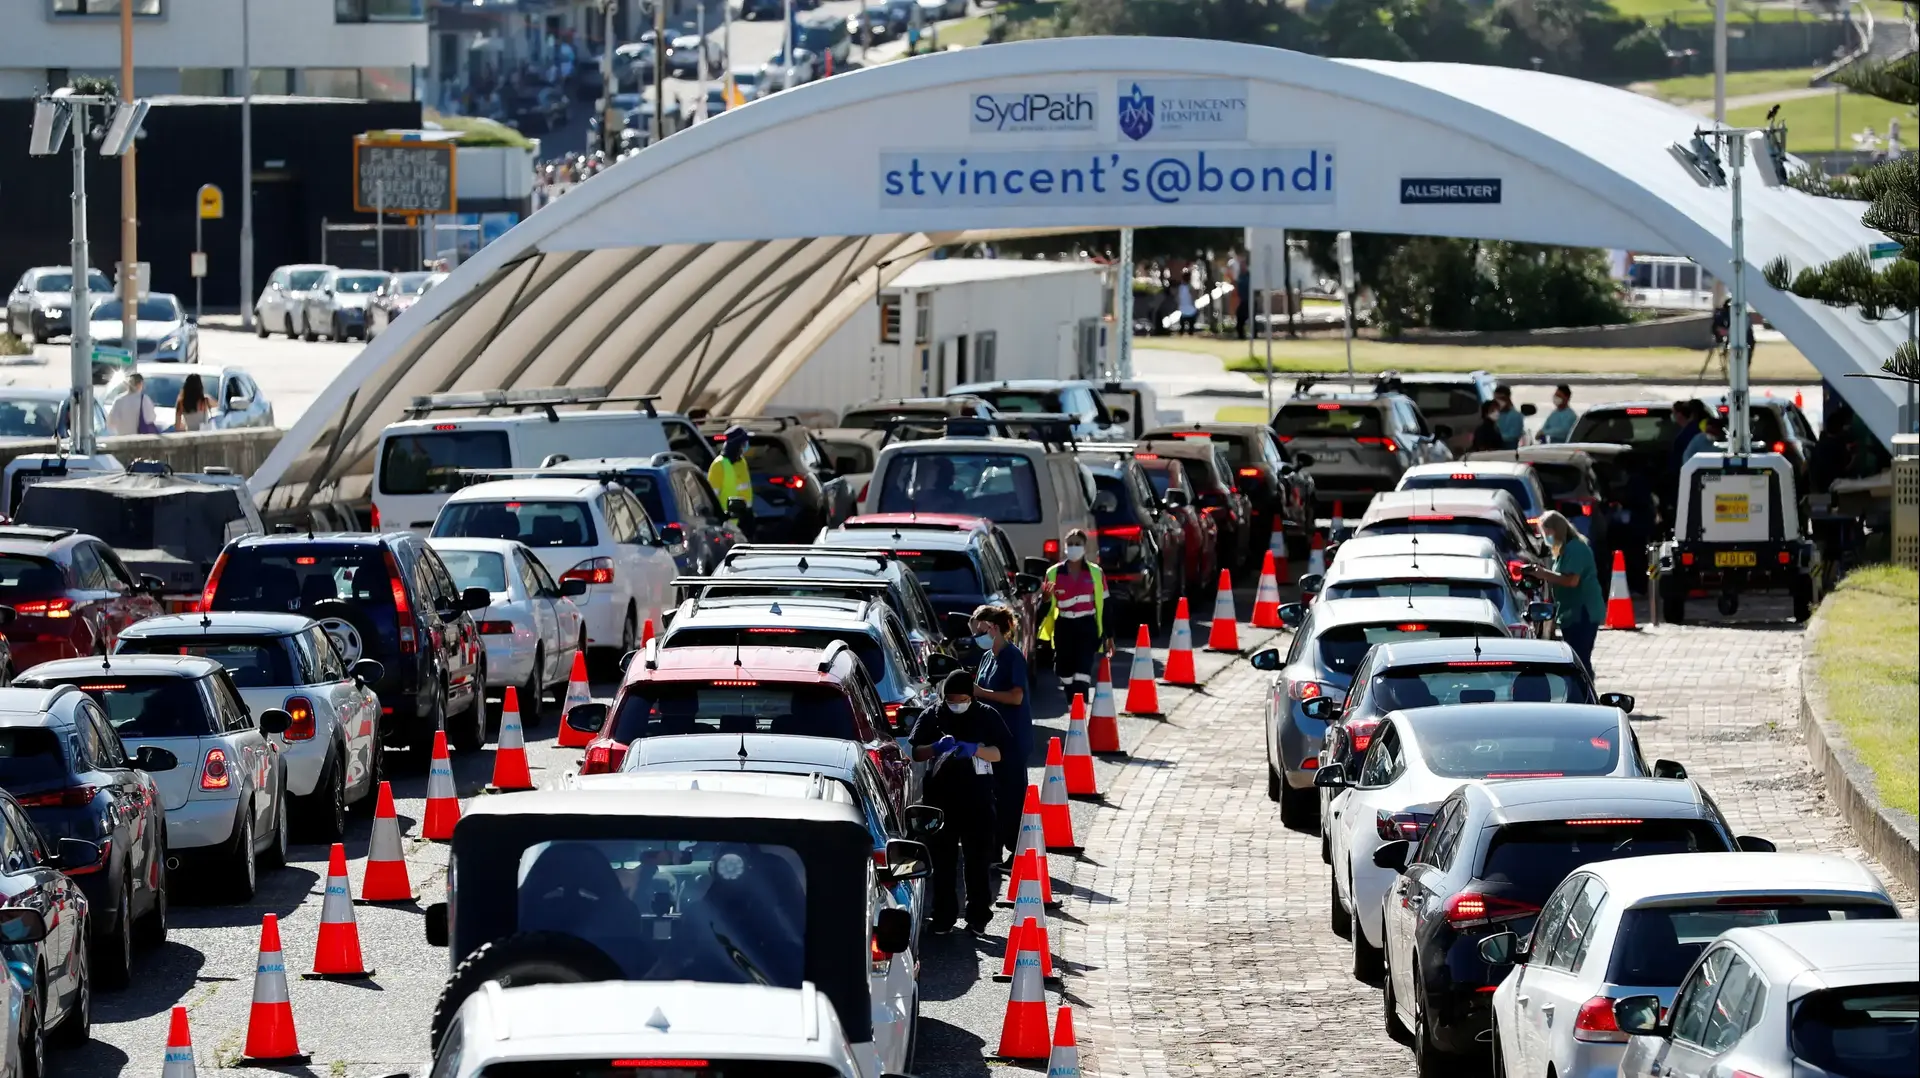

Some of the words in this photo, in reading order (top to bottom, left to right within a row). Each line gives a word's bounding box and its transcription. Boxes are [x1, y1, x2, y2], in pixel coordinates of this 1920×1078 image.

[975, 93, 1094, 131] SydPath
[1160, 99, 1175, 110] ST
[1160, 110, 1223, 122] HOSPITAL
[884, 150, 1334, 203] stvincent's@bondi
